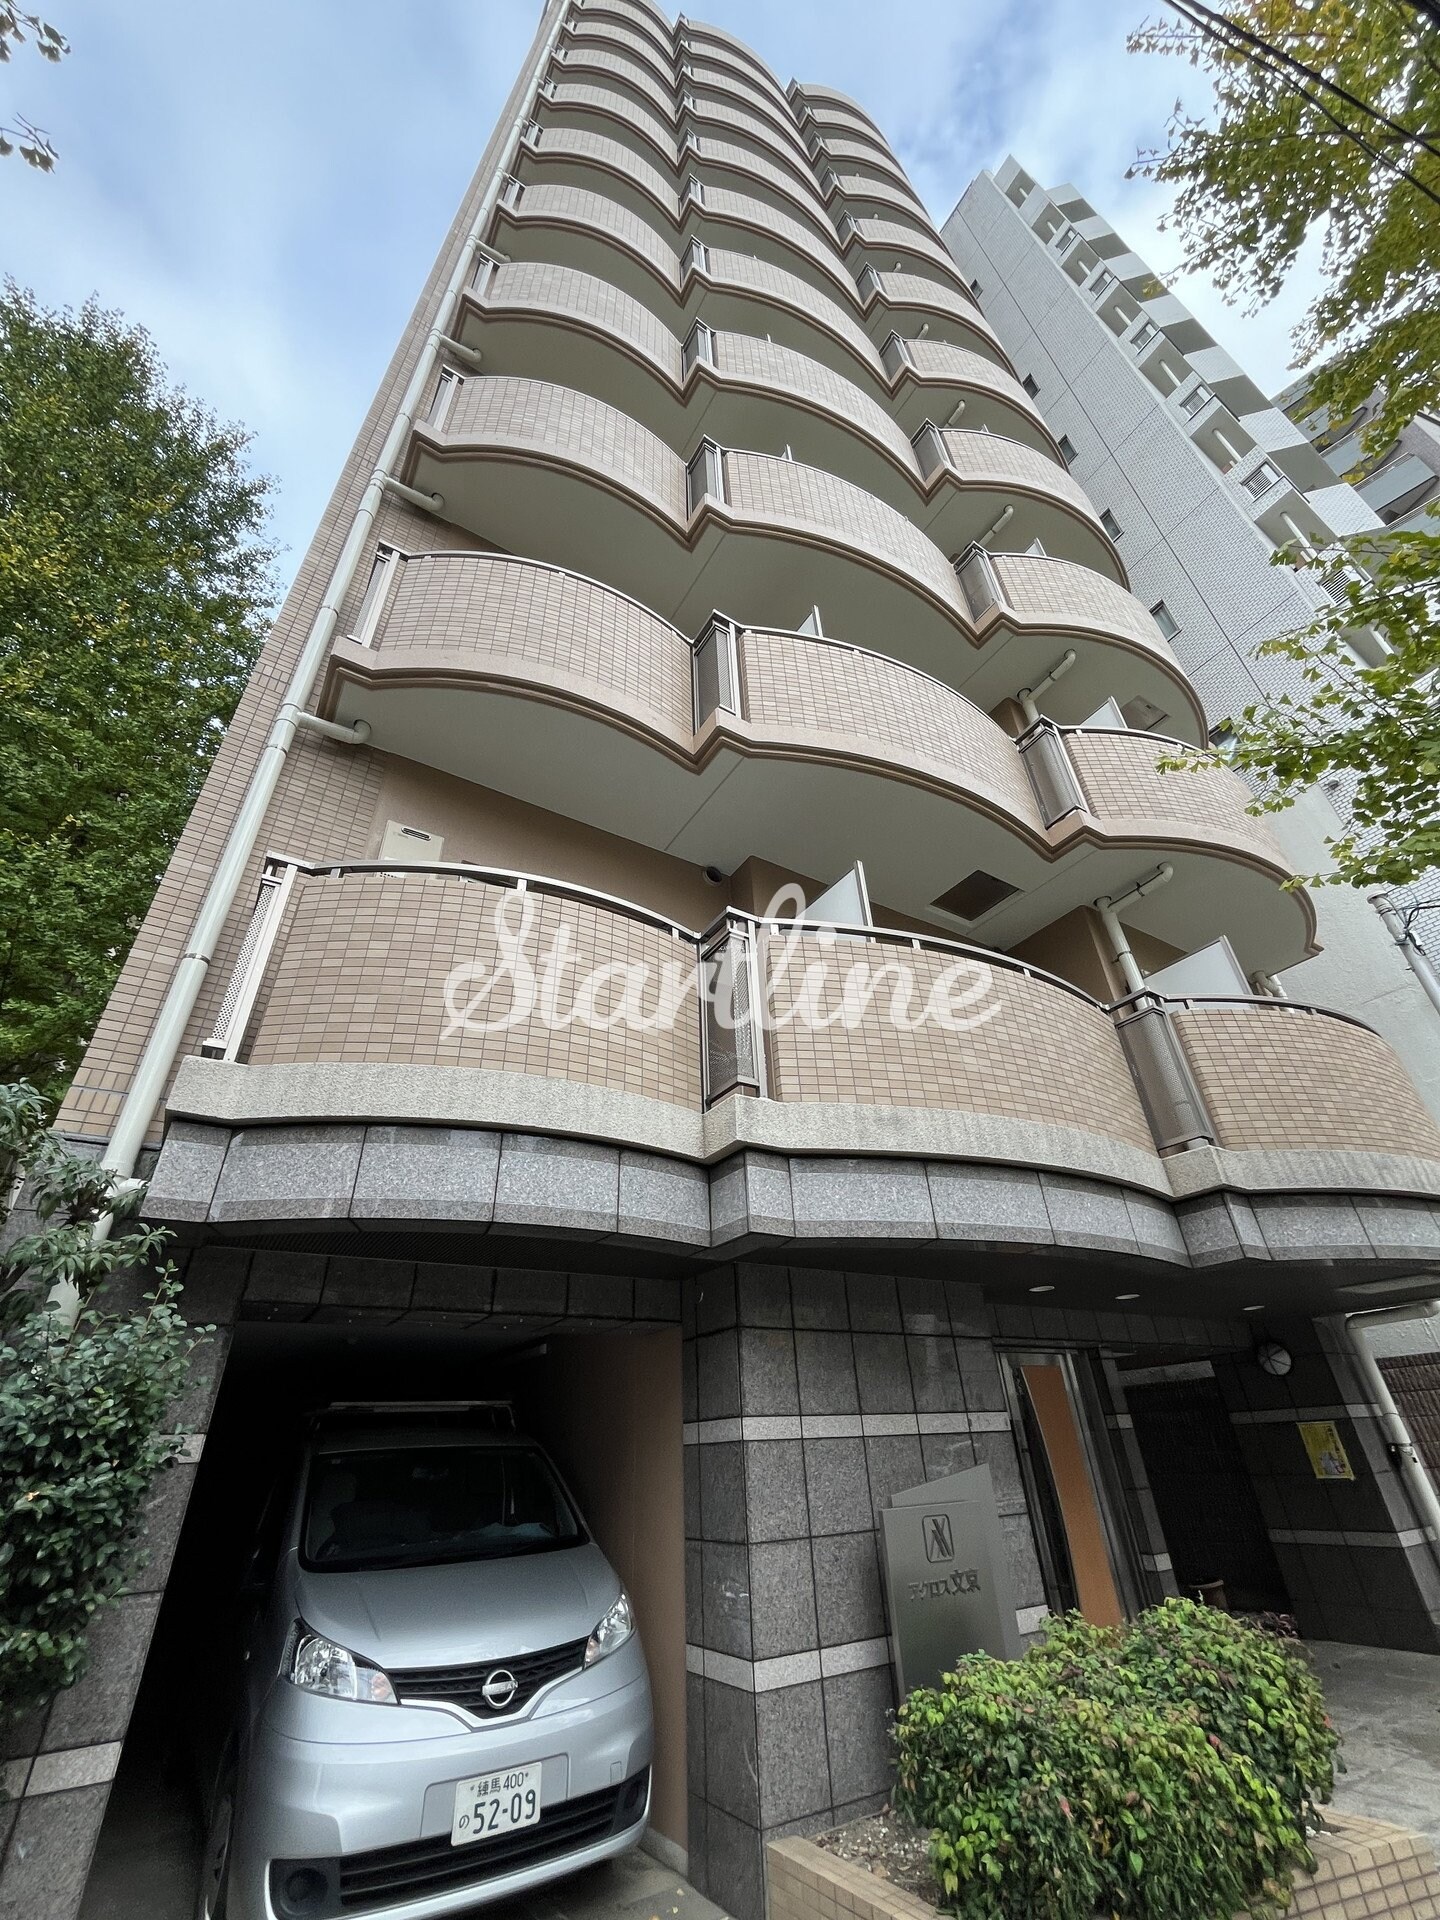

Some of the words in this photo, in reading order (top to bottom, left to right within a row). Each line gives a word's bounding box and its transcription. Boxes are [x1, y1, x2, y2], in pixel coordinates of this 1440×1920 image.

[907, 1567, 982, 1602] アクロス文京
[503, 1772, 525, 1790] 400
[459, 1814, 470, 1829] の
[473, 1789, 536, 1834] 52-09
